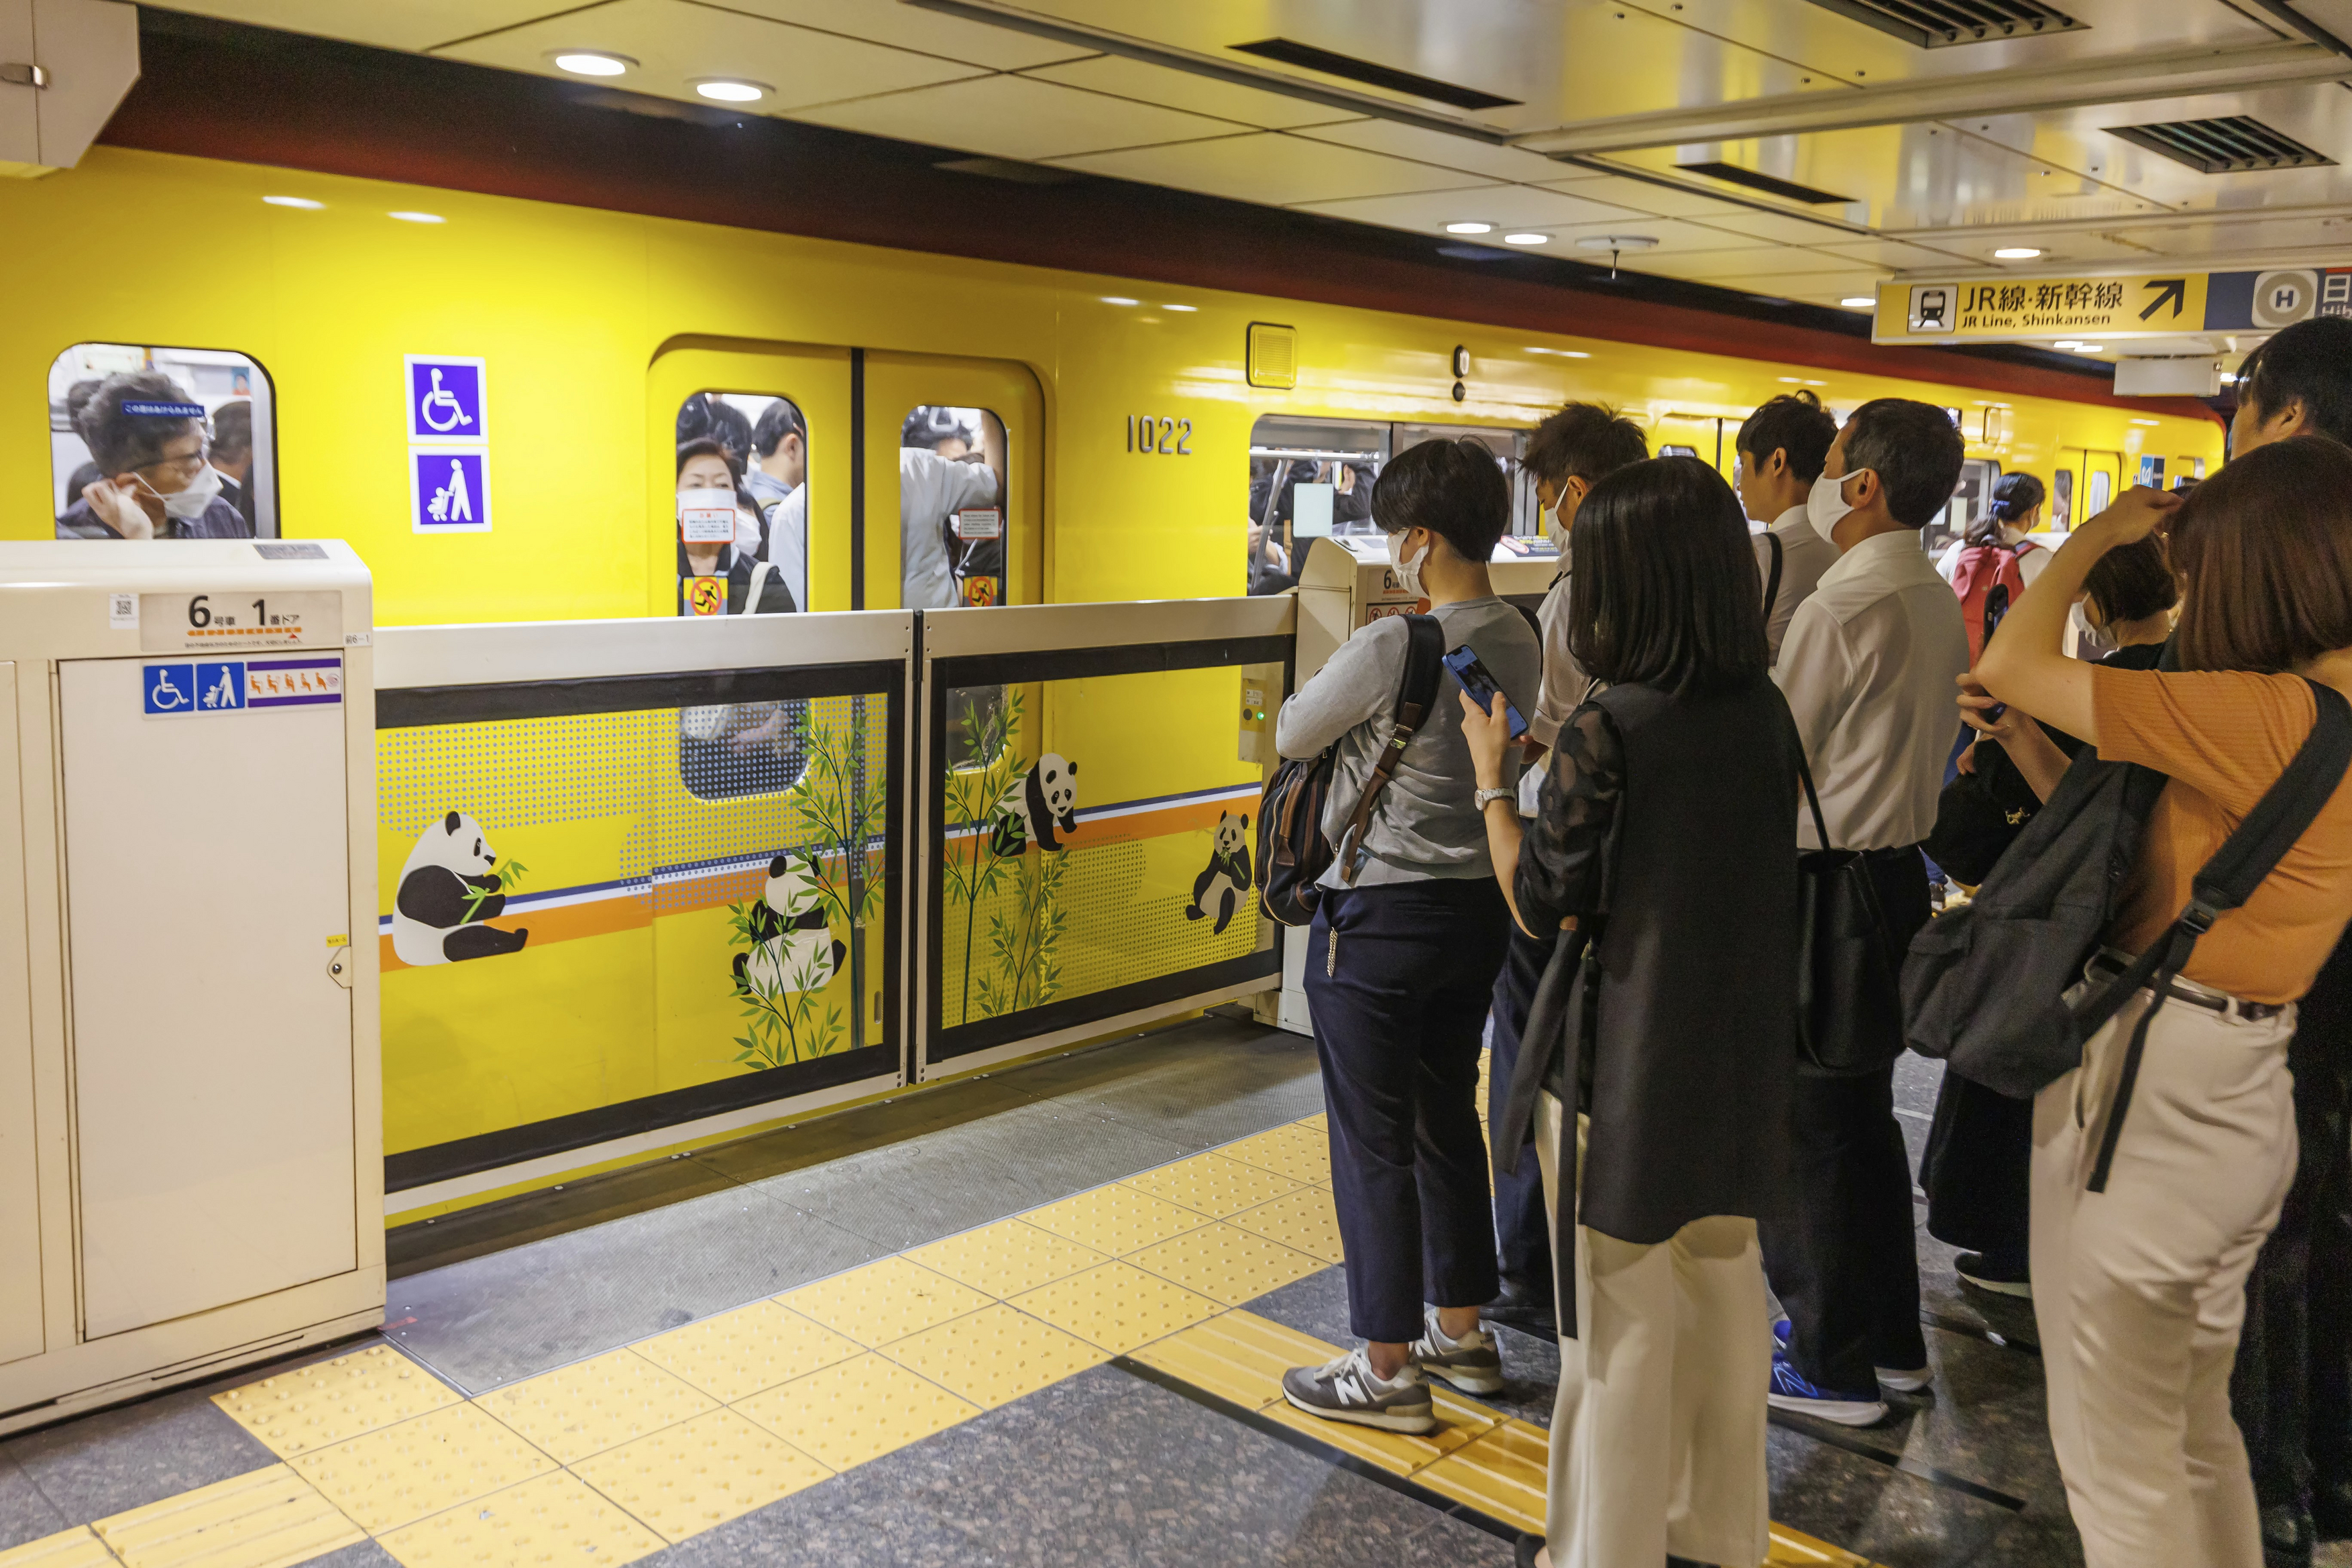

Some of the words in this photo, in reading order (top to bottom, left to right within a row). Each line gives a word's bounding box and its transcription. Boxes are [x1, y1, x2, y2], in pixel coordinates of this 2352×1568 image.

[2276, 290, 2294, 308] H
[1962, 315, 1977, 328] JR
[1982, 313, 2017, 329] Line,
[2022, 311, 2111, 326] Shinkansen
[1127, 414, 1192, 455] 1022
[1334, 1375, 1368, 1406] N
